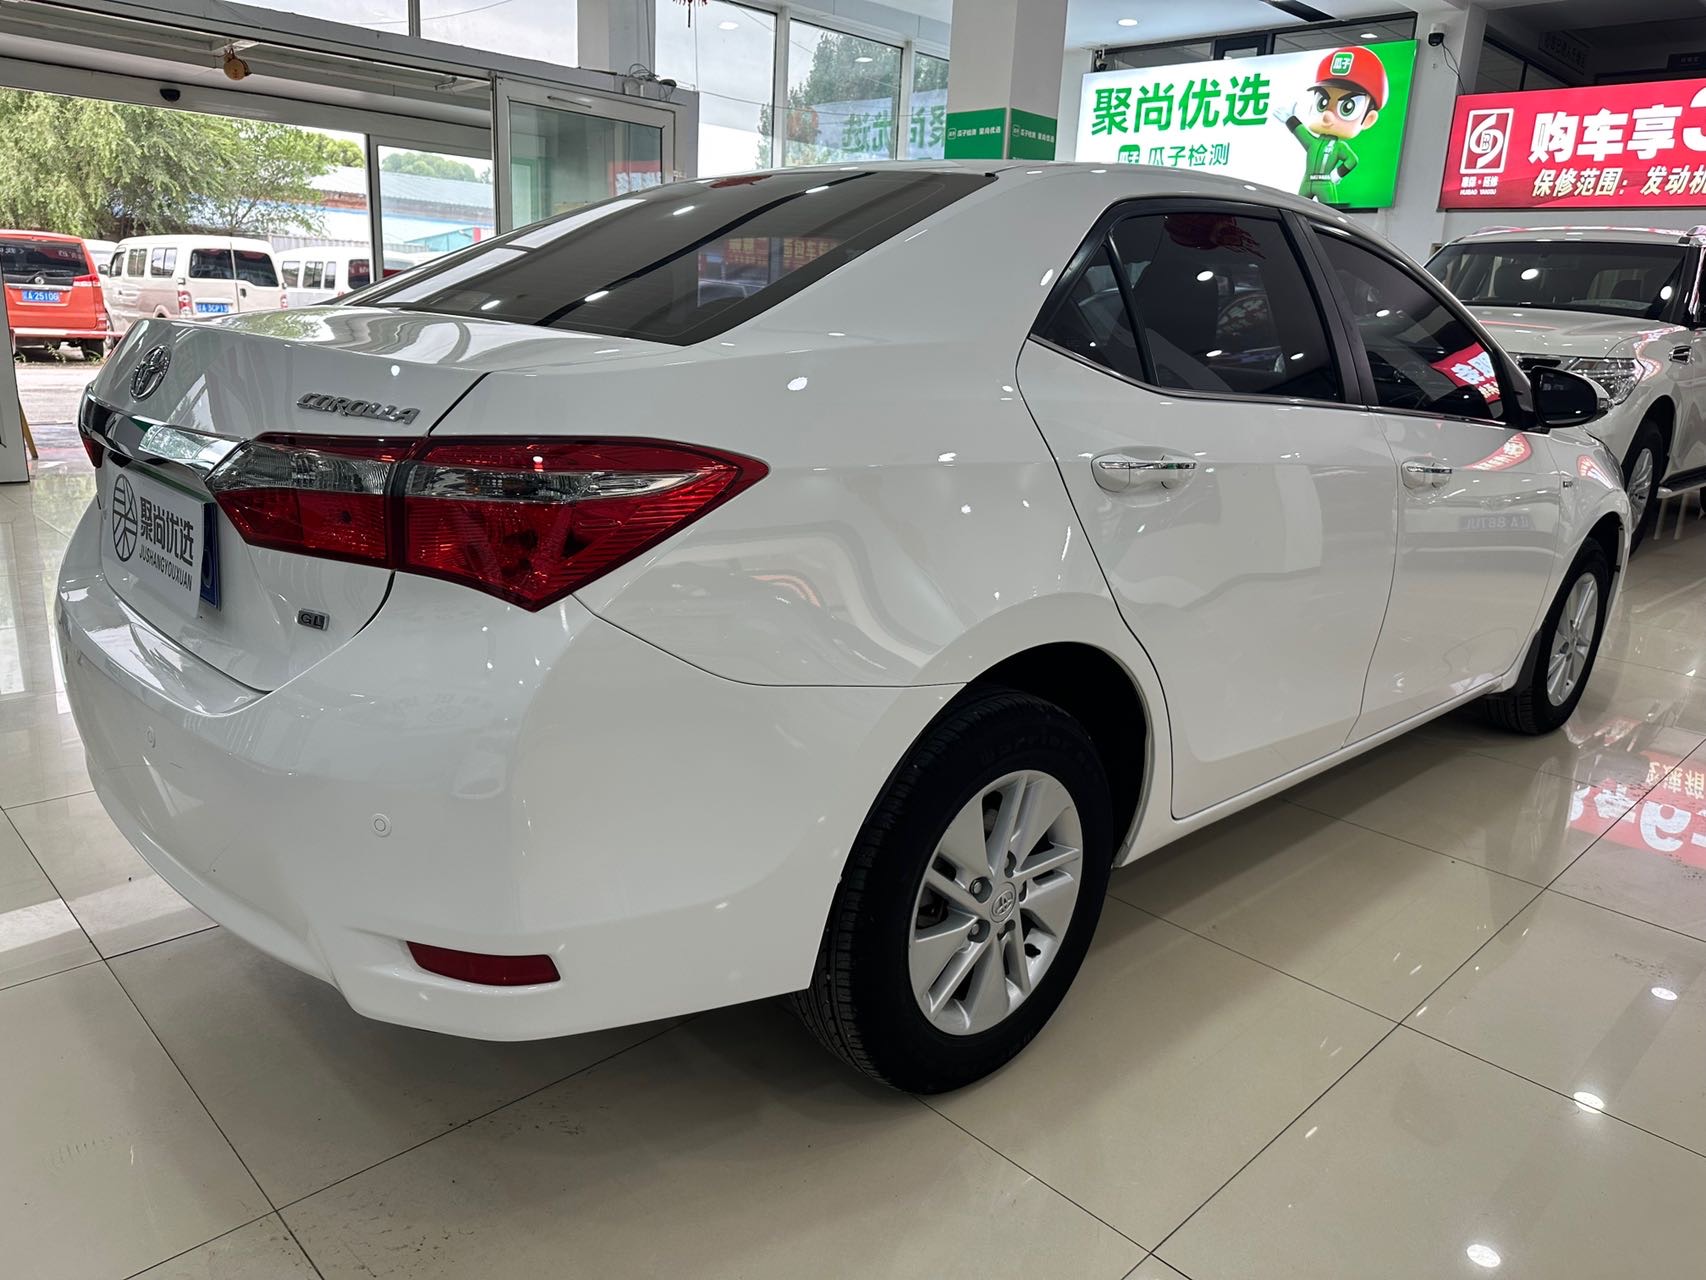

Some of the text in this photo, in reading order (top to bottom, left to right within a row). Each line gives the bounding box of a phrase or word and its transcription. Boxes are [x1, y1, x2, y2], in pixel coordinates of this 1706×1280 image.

[1091, 73, 1270, 135] 聚尚优选
[1148, 142, 1230, 167] 瓜子检测
[296, 393, 420, 425] COROLLA
[140, 496, 194, 567] 聚尚优选
[139, 544, 192, 591] JUSHANGYOUXUAN
[300, 612, 325, 628] GL
